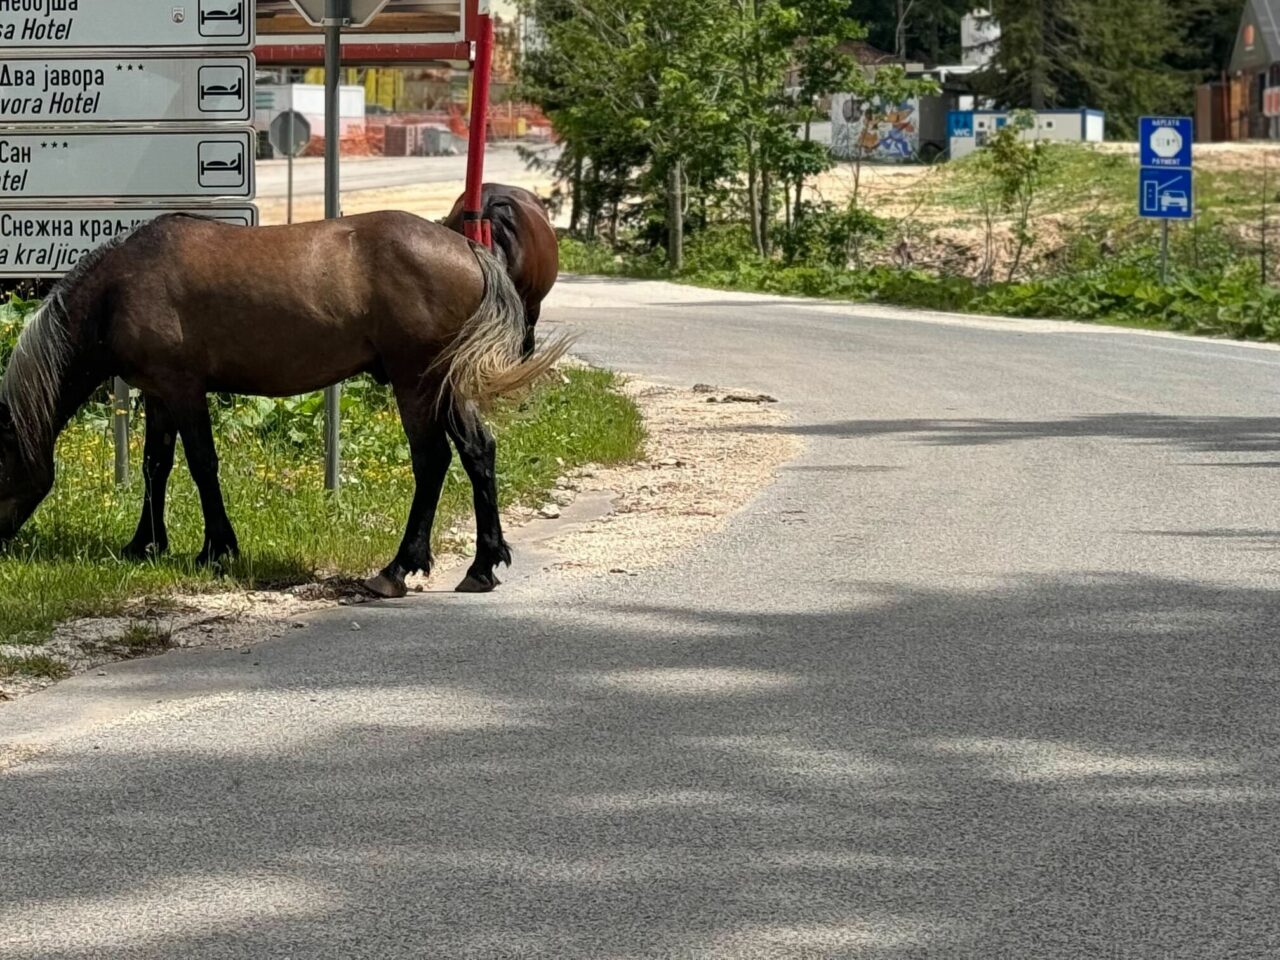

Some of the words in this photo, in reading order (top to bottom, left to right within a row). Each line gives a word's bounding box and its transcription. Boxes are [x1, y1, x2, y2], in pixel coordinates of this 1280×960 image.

[21, 17, 73, 41] Hotel
[42, 63, 105, 92] јавора
[48, 91, 101, 114] Hotel
[953, 128, 971, 137] WC
[1, 213, 73, 237] Снежна
